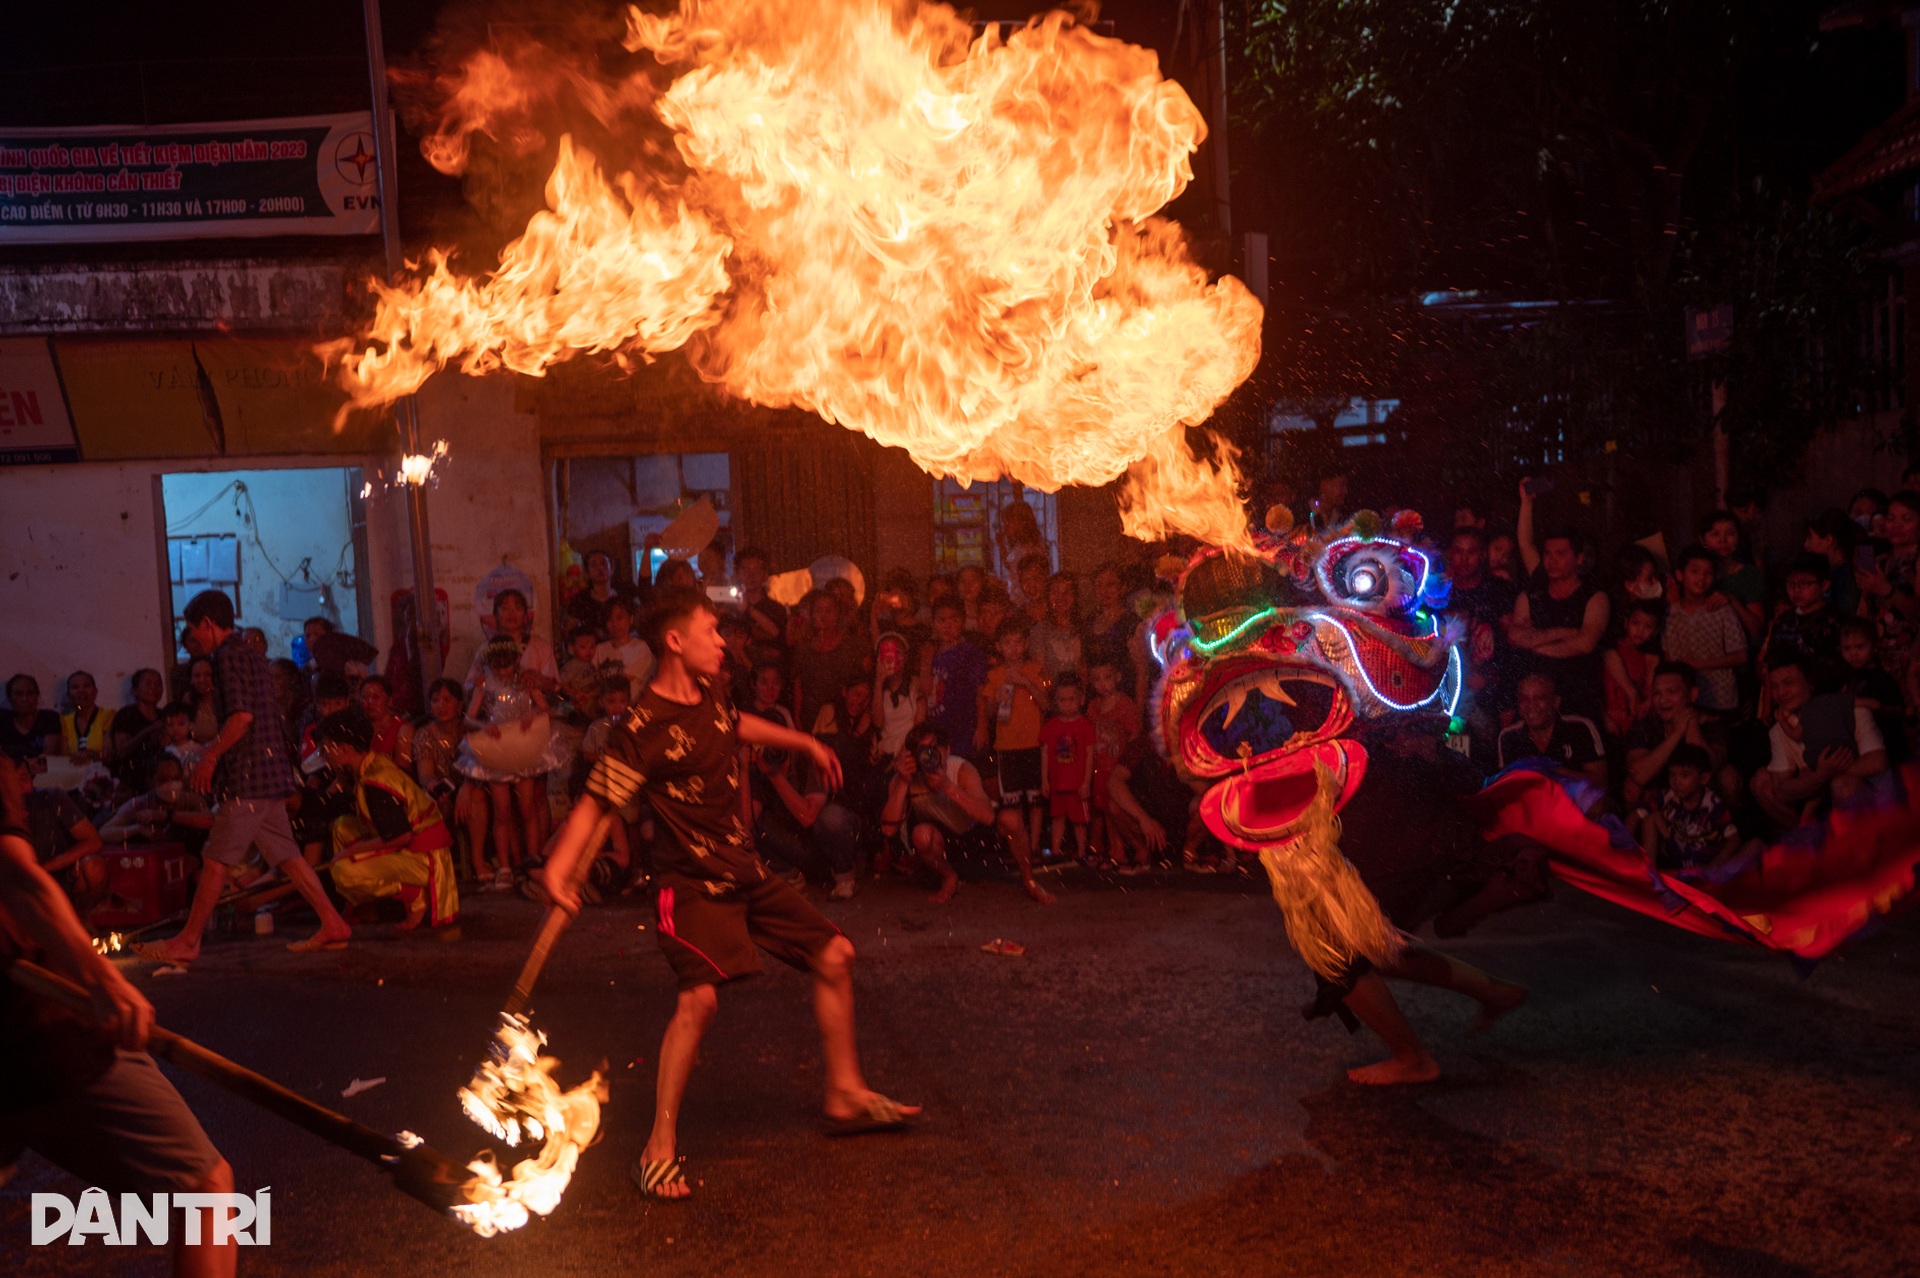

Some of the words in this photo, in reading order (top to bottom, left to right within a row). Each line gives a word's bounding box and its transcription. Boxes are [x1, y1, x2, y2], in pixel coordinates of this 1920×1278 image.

[29, 143, 70, 169] QUỐC
[70, 147, 99, 167] GIA
[120, 141, 151, 165] TIẾT
[153, 141, 193, 167] KIỆM
[194, 140, 231, 167] ĐIỆN
[232, 139, 268, 162] NĂM
[270, 139, 307, 160] 2023
[15, 171, 51, 198] ĐIỆN
[53, 172, 105, 194] KHÔNG
[140, 168, 182, 191] THIẾT
[1, 205, 27, 221] CAO
[75, 201, 94, 218] TỪ
[95, 203, 129, 218] 9H30
[141, 201, 182, 216] 11H30
[185, 197, 203, 216] VÀ
[205, 199, 247, 214] 17H00
[258, 196, 305, 213] 20H00)
[344, 195, 382, 210] EVN
